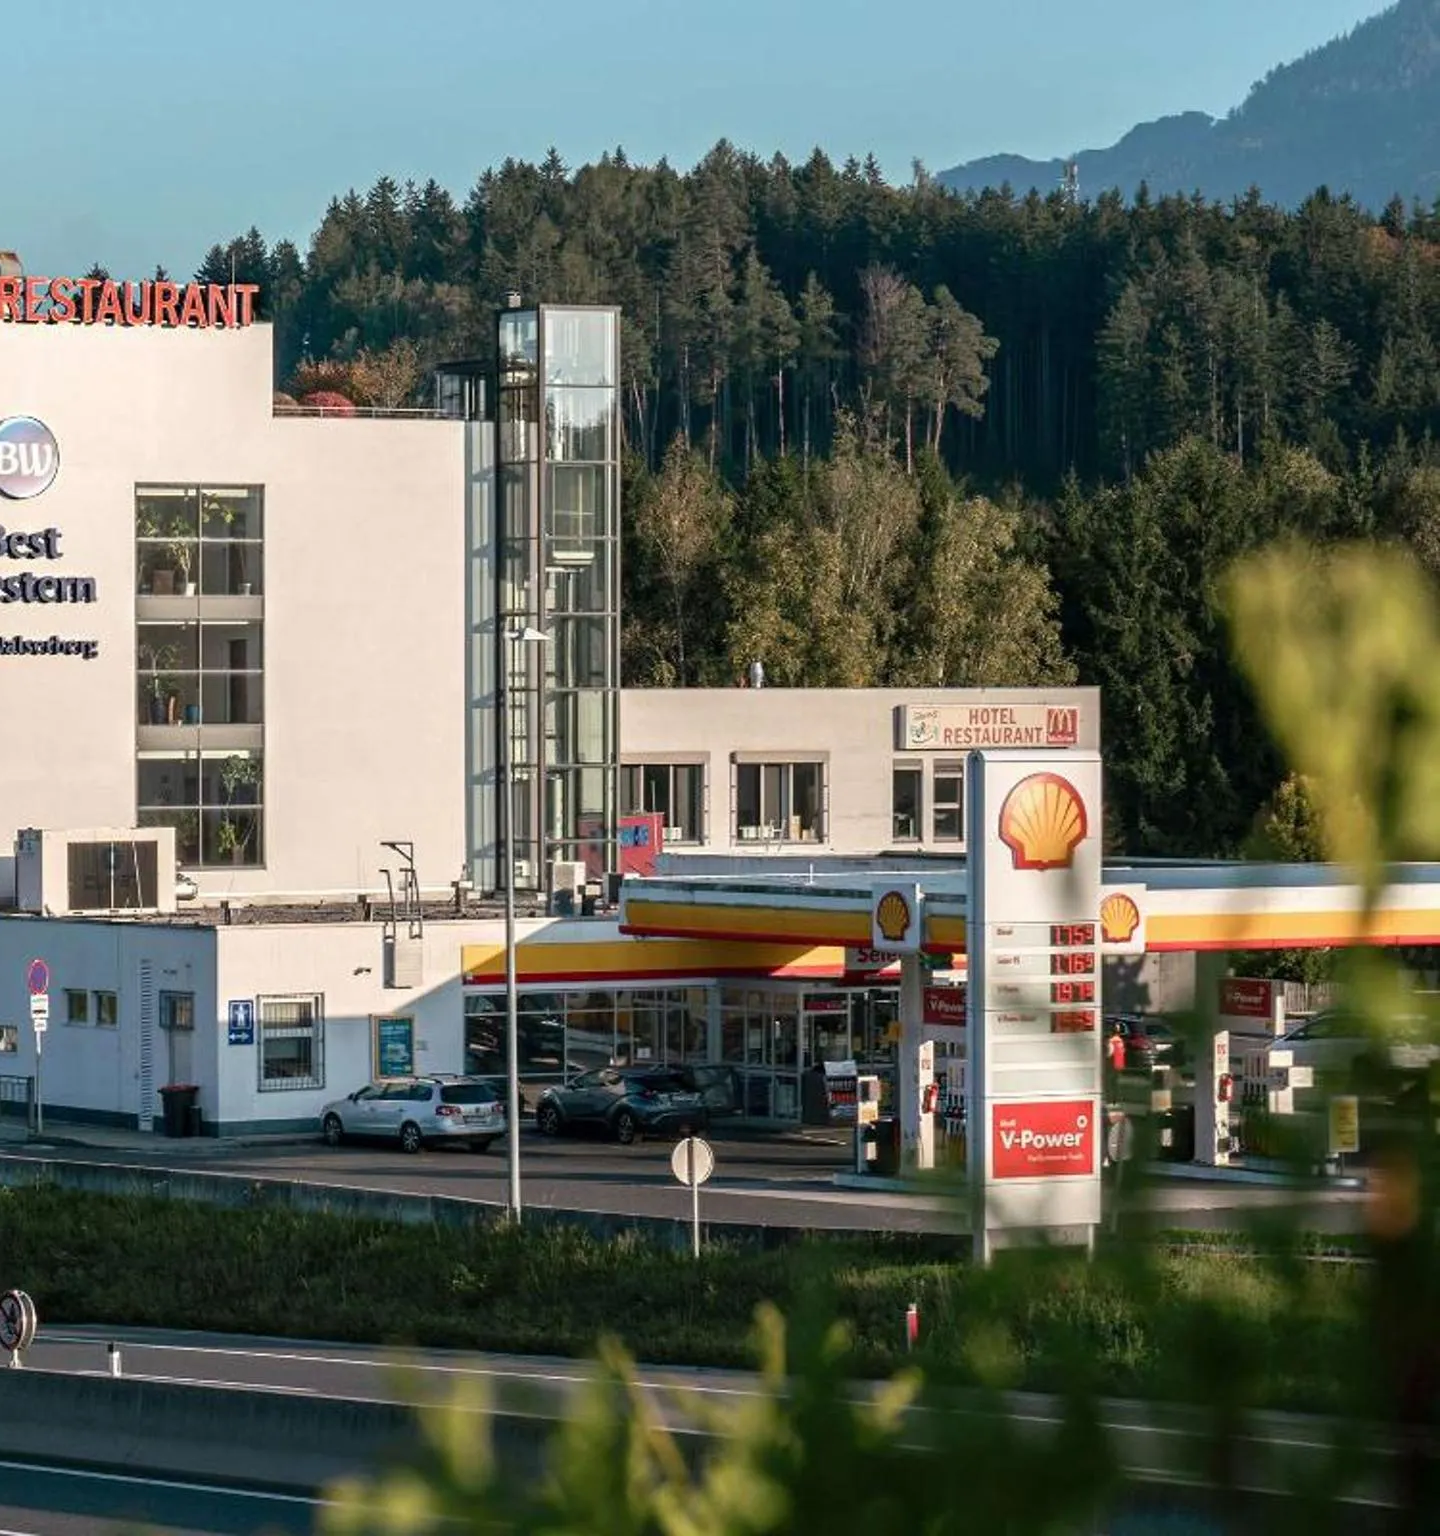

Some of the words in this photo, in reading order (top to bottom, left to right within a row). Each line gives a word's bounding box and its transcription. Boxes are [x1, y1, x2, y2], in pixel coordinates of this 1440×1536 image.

[968, 708, 1017, 725] HOTEL
[943, 726, 1044, 745] RESTAURANT
[1000, 1129, 1084, 1150] V-Power
